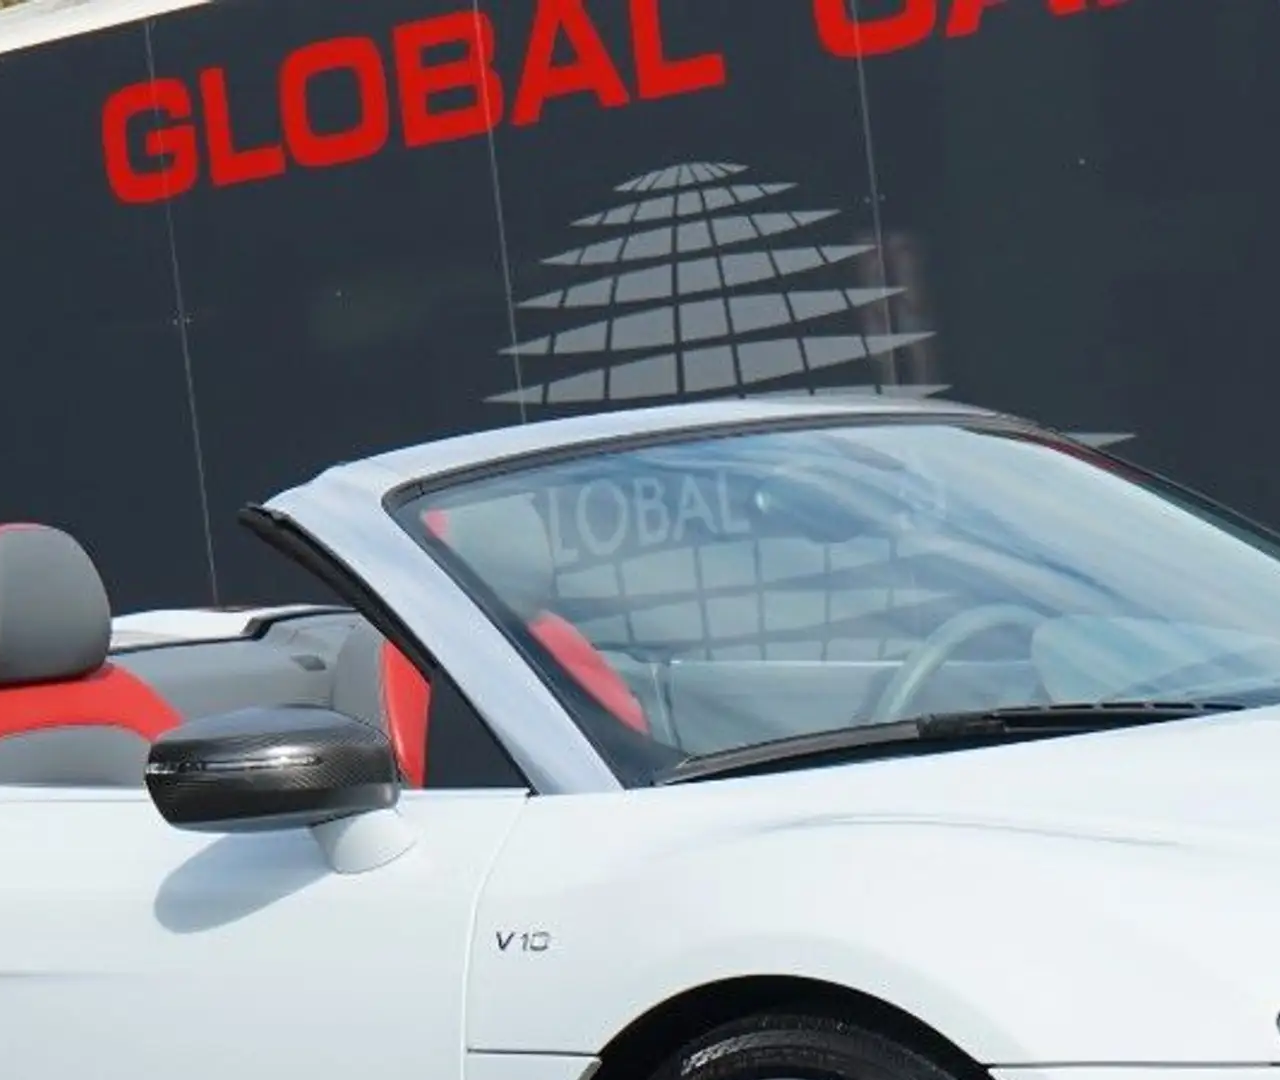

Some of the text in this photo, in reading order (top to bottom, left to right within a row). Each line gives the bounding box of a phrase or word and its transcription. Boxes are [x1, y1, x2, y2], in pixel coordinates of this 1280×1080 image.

[101, 0, 726, 204] GLOBAL
[547, 470, 752, 563] LOBAL
[496, 931, 550, 951] V10
